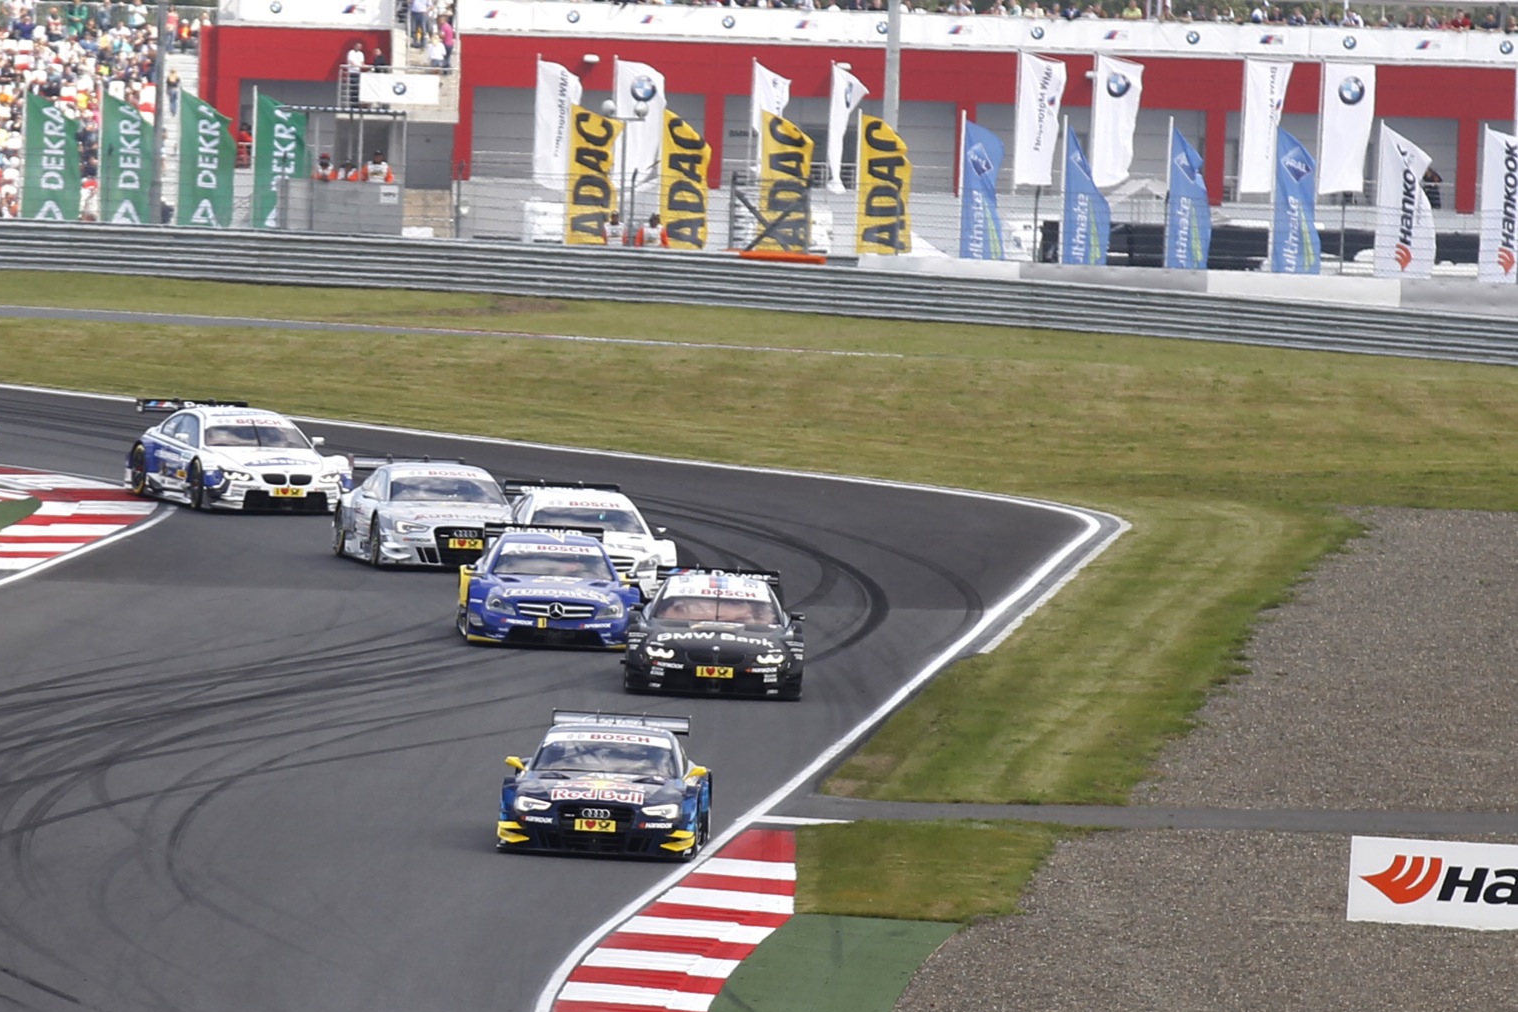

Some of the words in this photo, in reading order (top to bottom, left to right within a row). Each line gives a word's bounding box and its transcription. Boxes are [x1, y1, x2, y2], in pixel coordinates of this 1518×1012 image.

[40, 106, 66, 190] DEKRA
[117, 105, 142, 190] DEKRA
[196, 105, 221, 189] DEKRA
[271, 109, 297, 192] EKRA
[570, 112, 614, 237] ADAC
[666, 117, 707, 249] ADAC
[764, 117, 810, 248] ADAC
[862, 120, 906, 251] ADAC
[1398, 144, 1416, 246] Hanko
[428, 470, 477, 478] BOSCH
[537, 545, 590, 553] BOSCH
[700, 589, 757, 598] BOSCH
[657, 631, 716, 642] BMW
[720, 632, 775, 648] Bank
[590, 733, 650, 743] BOSCH
[552, 789, 597, 800] Red
[599, 790, 644, 804] Bull
[1436, 866, 1518, 905] Ha
